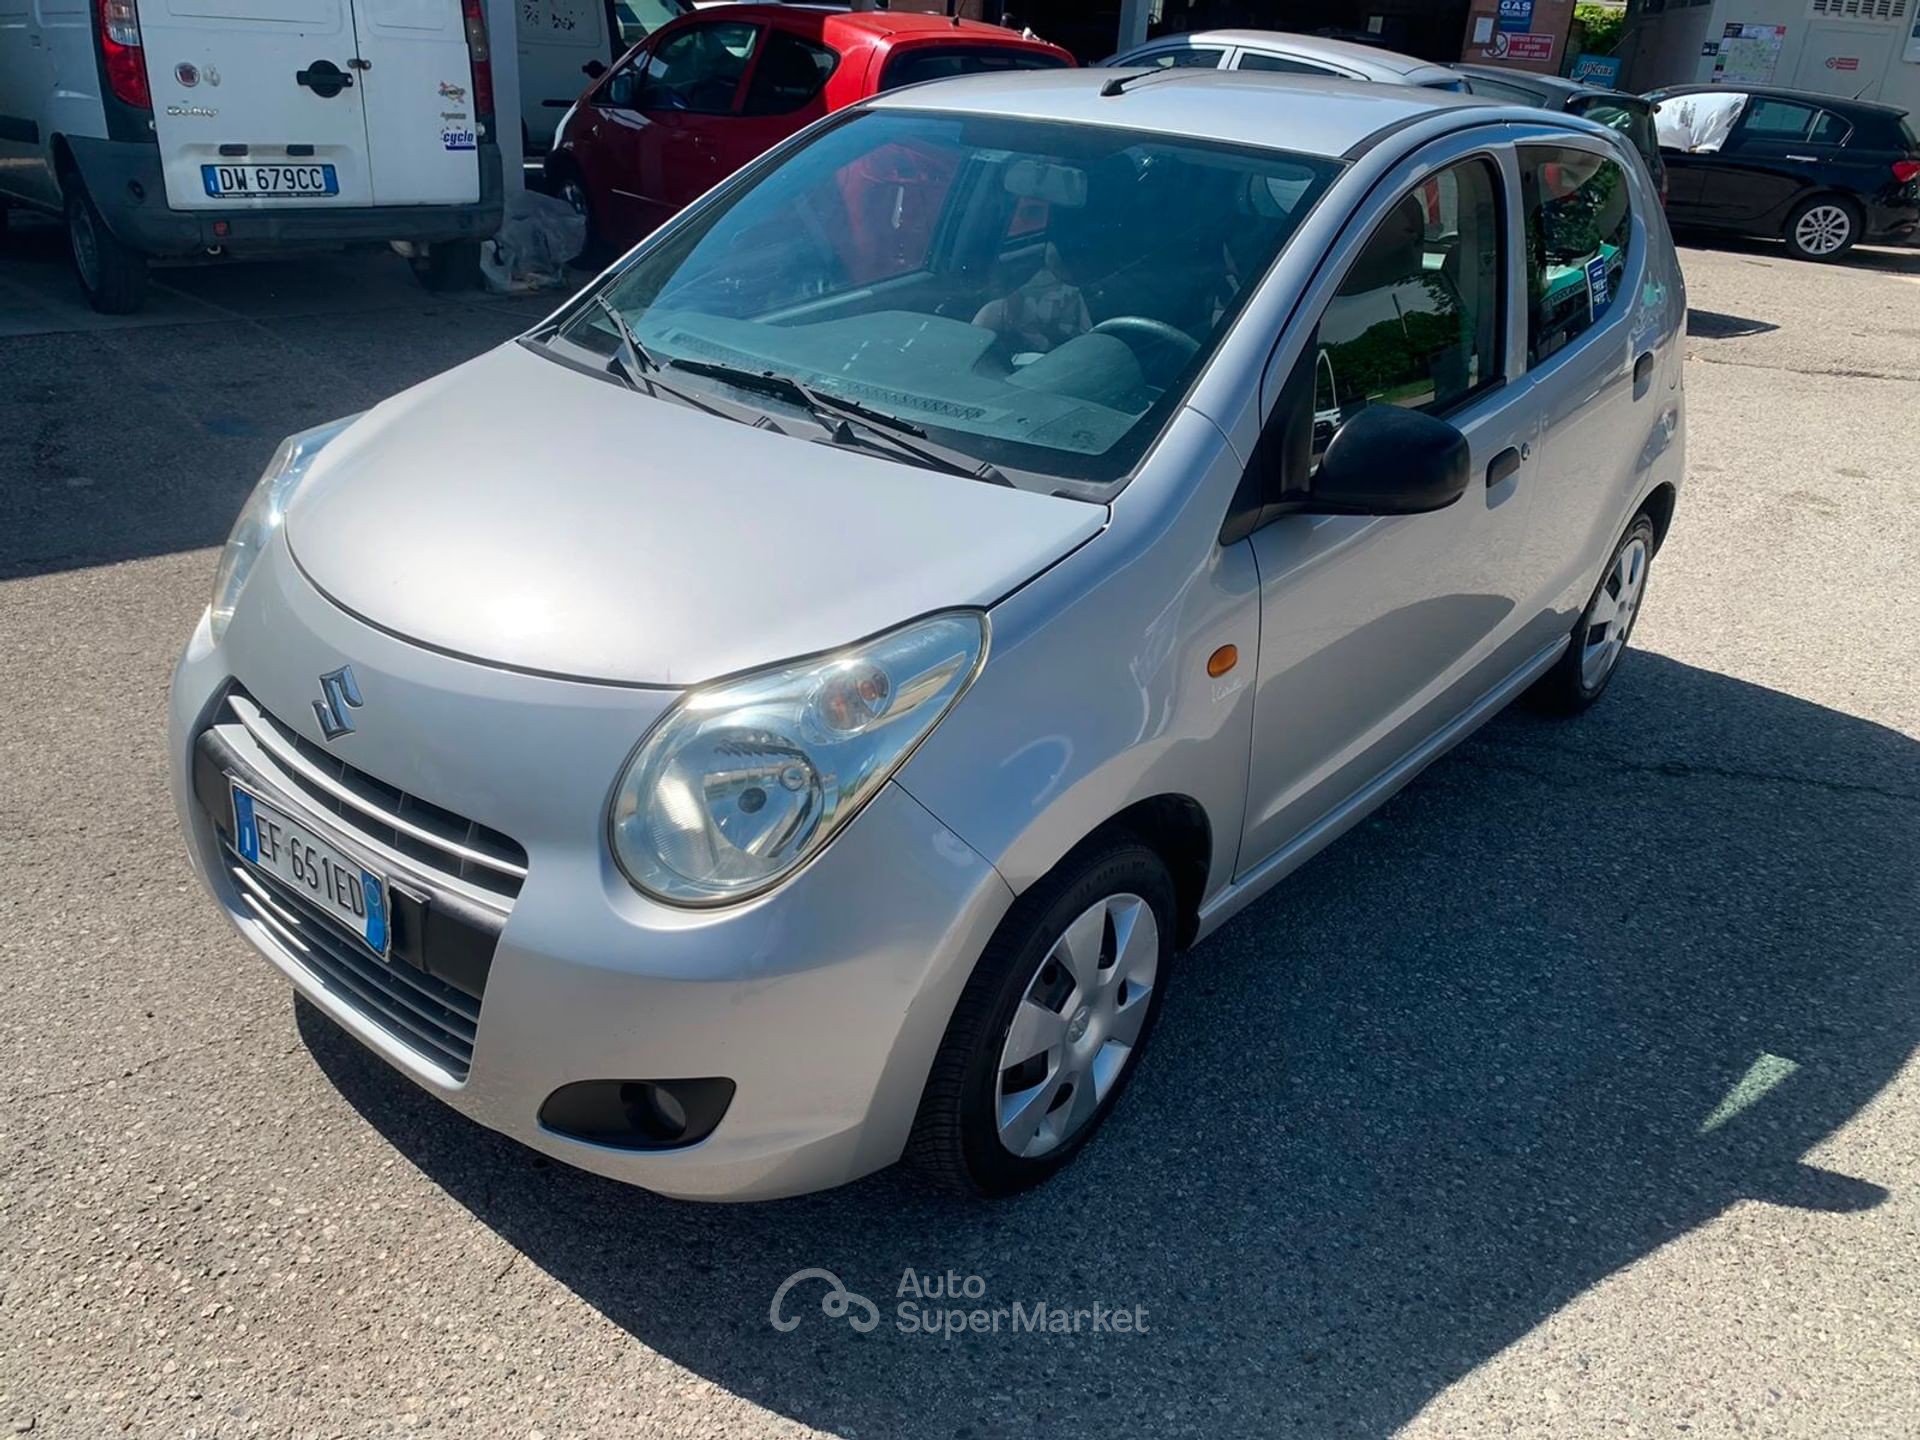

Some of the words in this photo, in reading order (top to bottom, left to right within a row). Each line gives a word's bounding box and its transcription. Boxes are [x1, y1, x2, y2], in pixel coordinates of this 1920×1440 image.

[1501, 1, 1532, 10] GAS
[443, 129, 474, 145] cyclo
[219, 168, 248, 190] DW
[256, 168, 323, 190] 679CC
[256, 814, 280, 862] EF
[291, 836, 364, 917] 651ED
